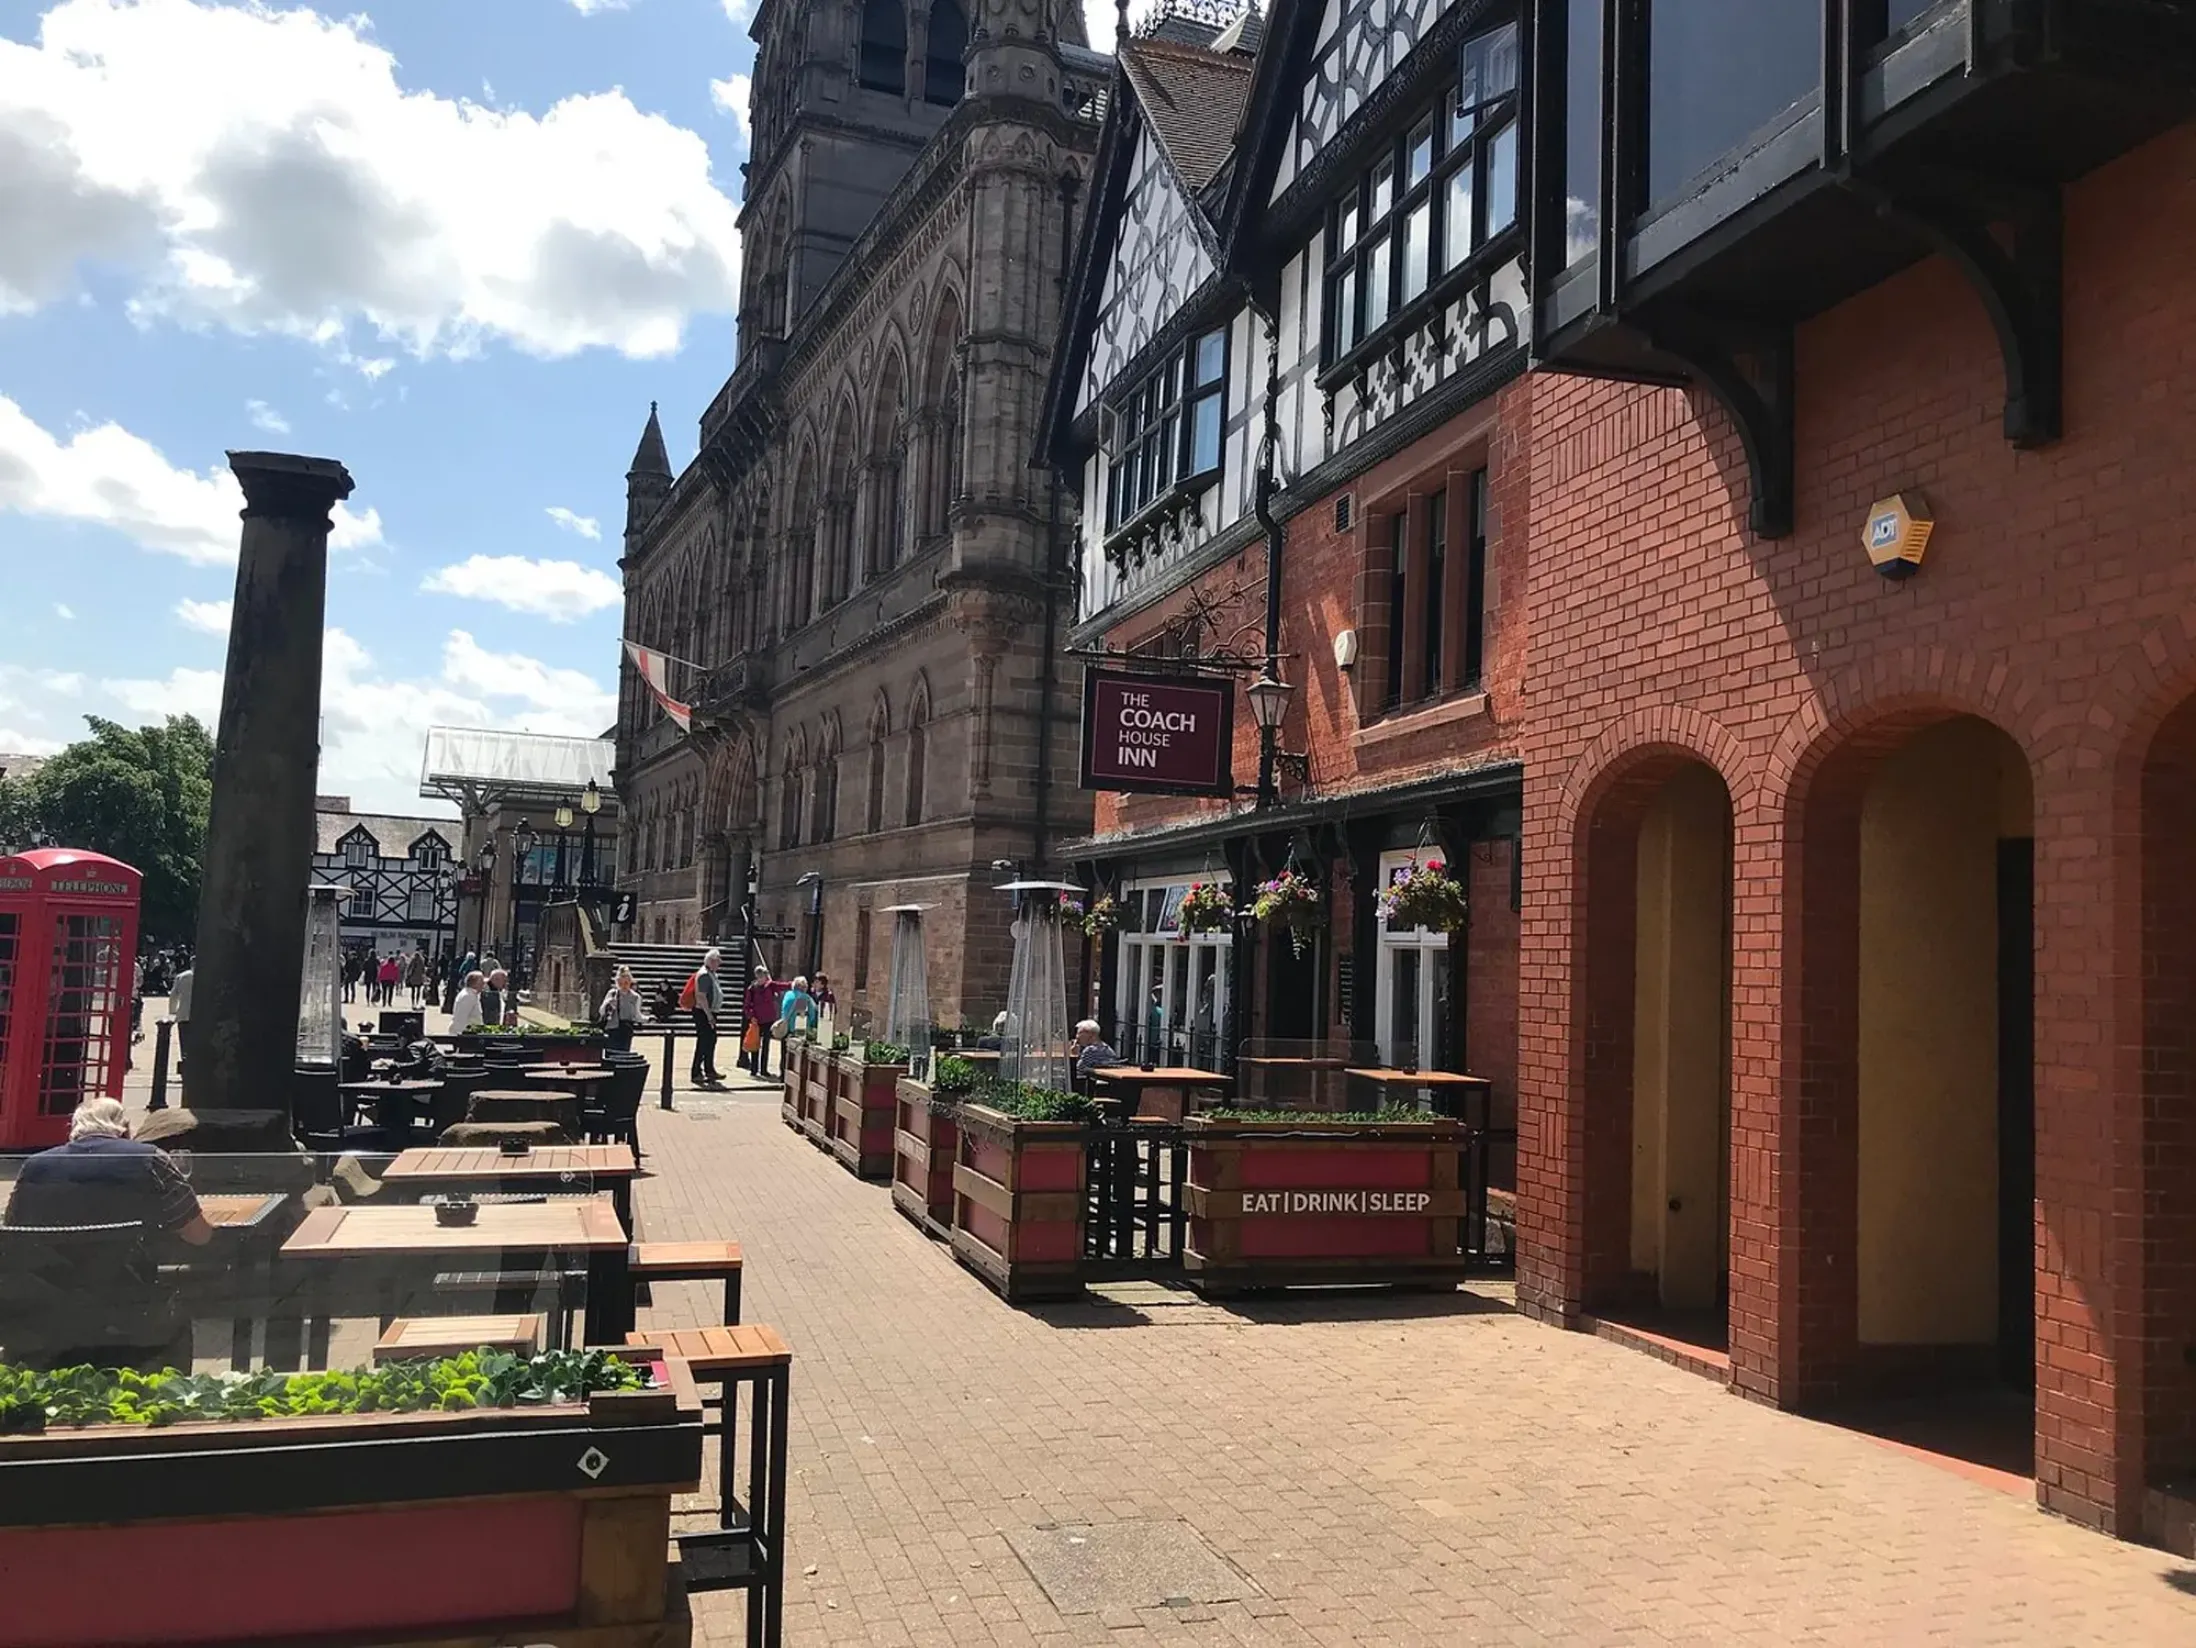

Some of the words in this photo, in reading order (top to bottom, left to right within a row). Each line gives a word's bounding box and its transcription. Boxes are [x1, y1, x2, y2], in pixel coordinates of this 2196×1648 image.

[1871, 518, 1897, 540] ADT
[1120, 691, 1151, 708] THE
[1119, 708, 1196, 732] COACH
[1118, 729, 1172, 747] HOUSE
[1117, 746, 1157, 768] INN
[52, 880, 127, 893] TELEPHONE
